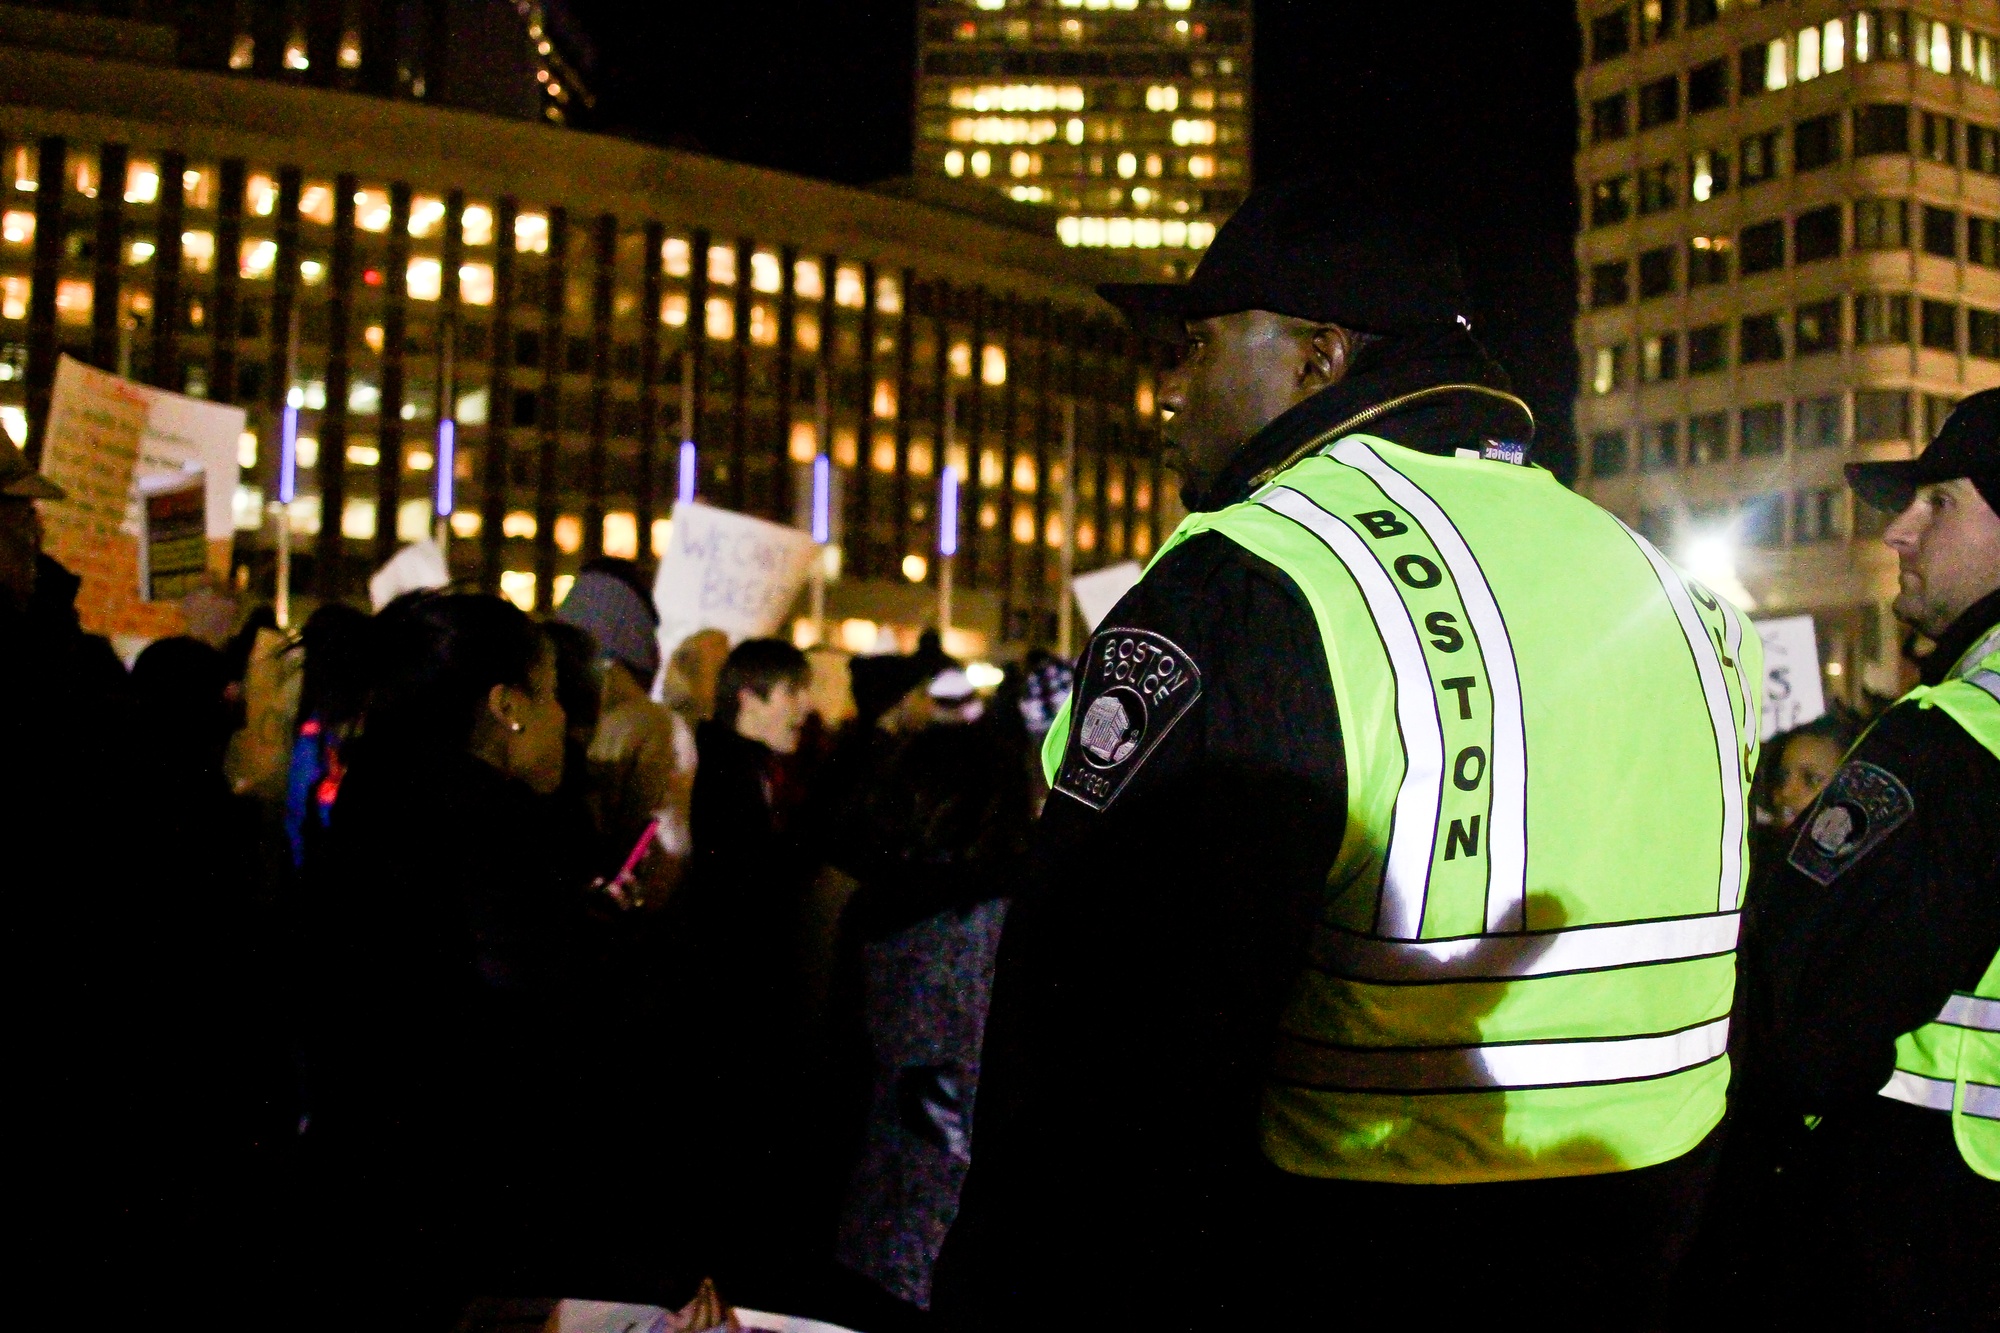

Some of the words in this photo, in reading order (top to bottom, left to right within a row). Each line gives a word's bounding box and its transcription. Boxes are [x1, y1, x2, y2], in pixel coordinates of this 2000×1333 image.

[1485, 447, 1524, 465] Blauer
[1103, 660, 1170, 706] POLICE
[1104, 638, 1189, 692] BOSTON
[1354, 510, 1486, 861] BOSTON
